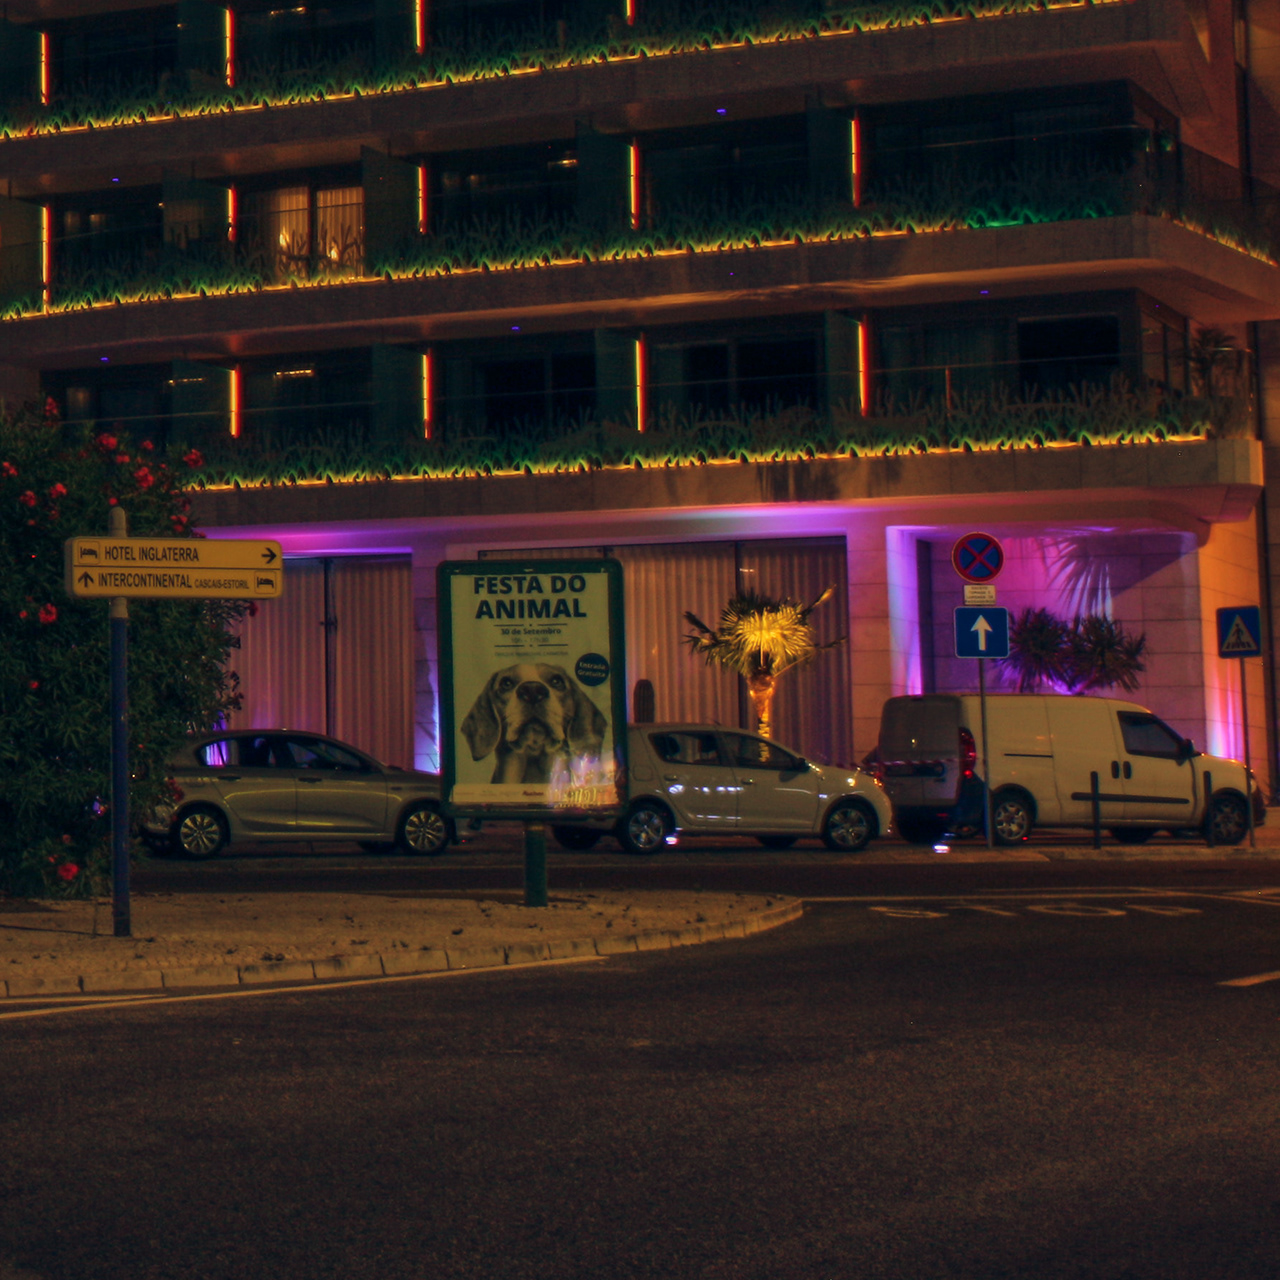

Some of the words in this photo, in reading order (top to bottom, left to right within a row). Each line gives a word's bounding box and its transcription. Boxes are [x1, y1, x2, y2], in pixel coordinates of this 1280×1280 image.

[104, 546, 136, 561] HOTEL
[139, 547, 199, 562] INGLATERRA
[98, 573, 192, 588] INTERCONTINENTAL
[473, 576, 544, 595] FESTA
[551, 575, 586, 593] DO
[475, 598, 587, 619] ANIMAL
[523, 627, 562, 635] Setembro
[577, 669, 606, 677] Gratuita
[579, 661, 606, 670] Entrada
